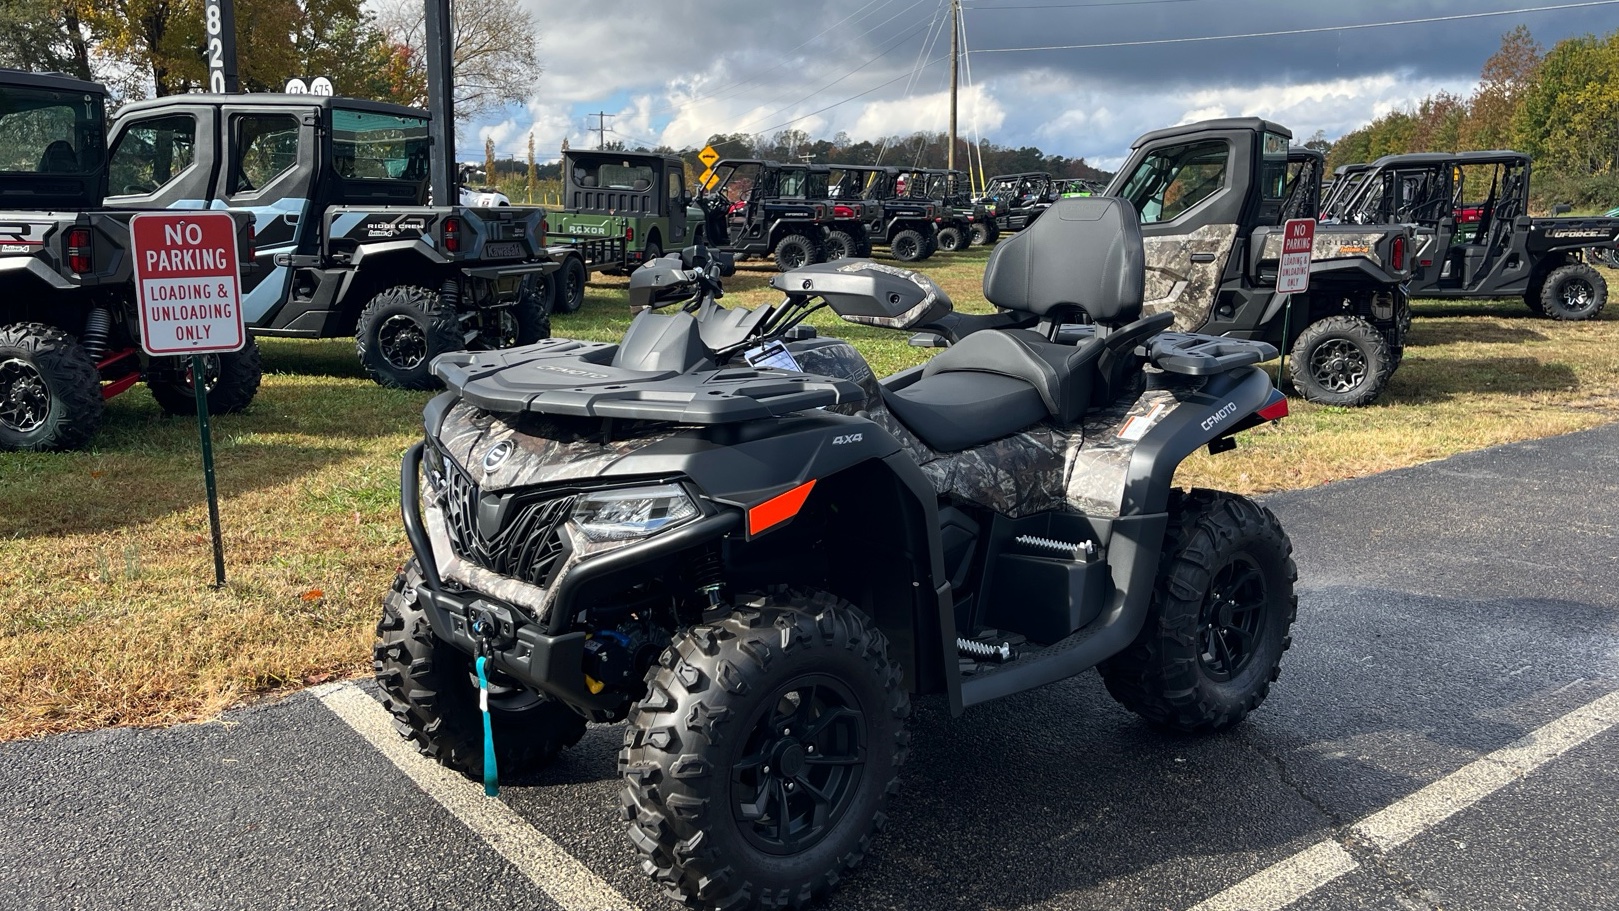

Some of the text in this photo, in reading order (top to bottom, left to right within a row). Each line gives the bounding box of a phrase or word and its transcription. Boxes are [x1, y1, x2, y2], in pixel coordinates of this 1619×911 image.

[207, 0, 225, 93] 820
[164, 223, 203, 246] NO
[569, 225, 605, 235] ROXOR
[1293, 224, 1306, 236] NO
[486, 244, 521, 258] Kawasaki
[1285, 238, 1311, 251] PARKING
[146, 248, 227, 272] PARKING
[1283, 256, 1303, 266] LOADING
[1287, 278, 1299, 287] ONLY
[151, 283, 228, 301] LOADING &
[152, 304, 232, 322] UNLOADING
[176, 325, 211, 341] ONLY
[1201, 402, 1237, 431] CFMOTO
